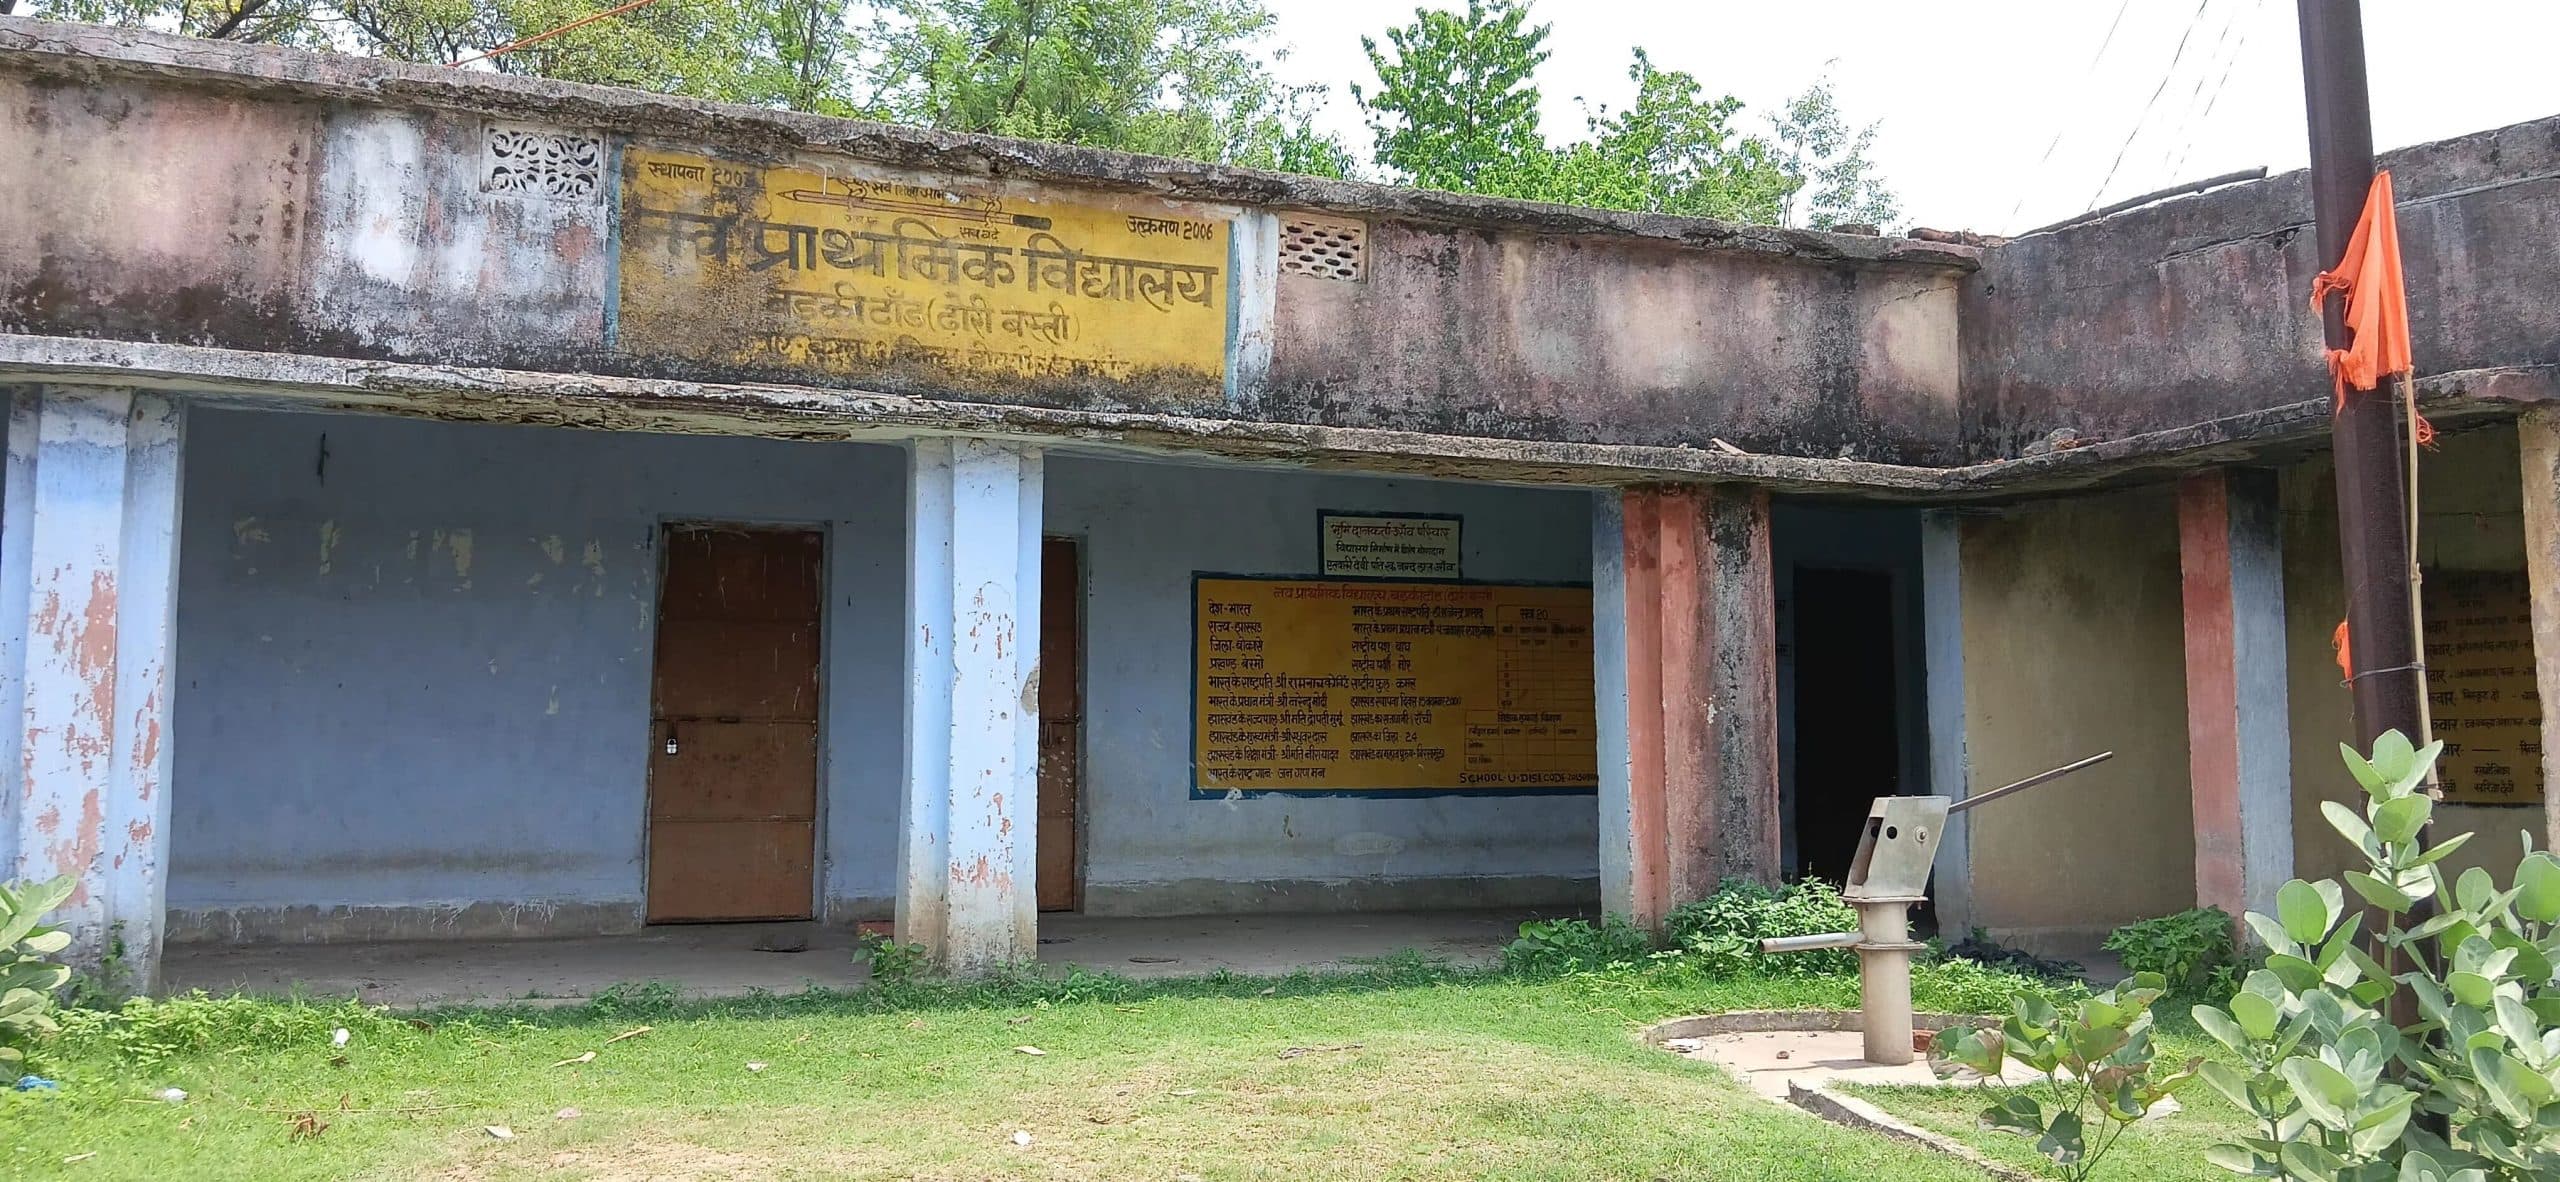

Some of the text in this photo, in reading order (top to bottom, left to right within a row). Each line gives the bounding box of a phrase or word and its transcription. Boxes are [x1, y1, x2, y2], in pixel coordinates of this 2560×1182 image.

[647, 161, 752, 188] स्थापना 200
[1126, 215, 1214, 241] उत्क्रमण 2006
[746, 212, 1015, 294] प्राथमिक
[1020, 231, 1220, 313] विद्यालय
[1275, 671, 1287, 689] श्री
[1405, 731, 1418, 743] 24
[1279, 768, 1294, 779] जन
